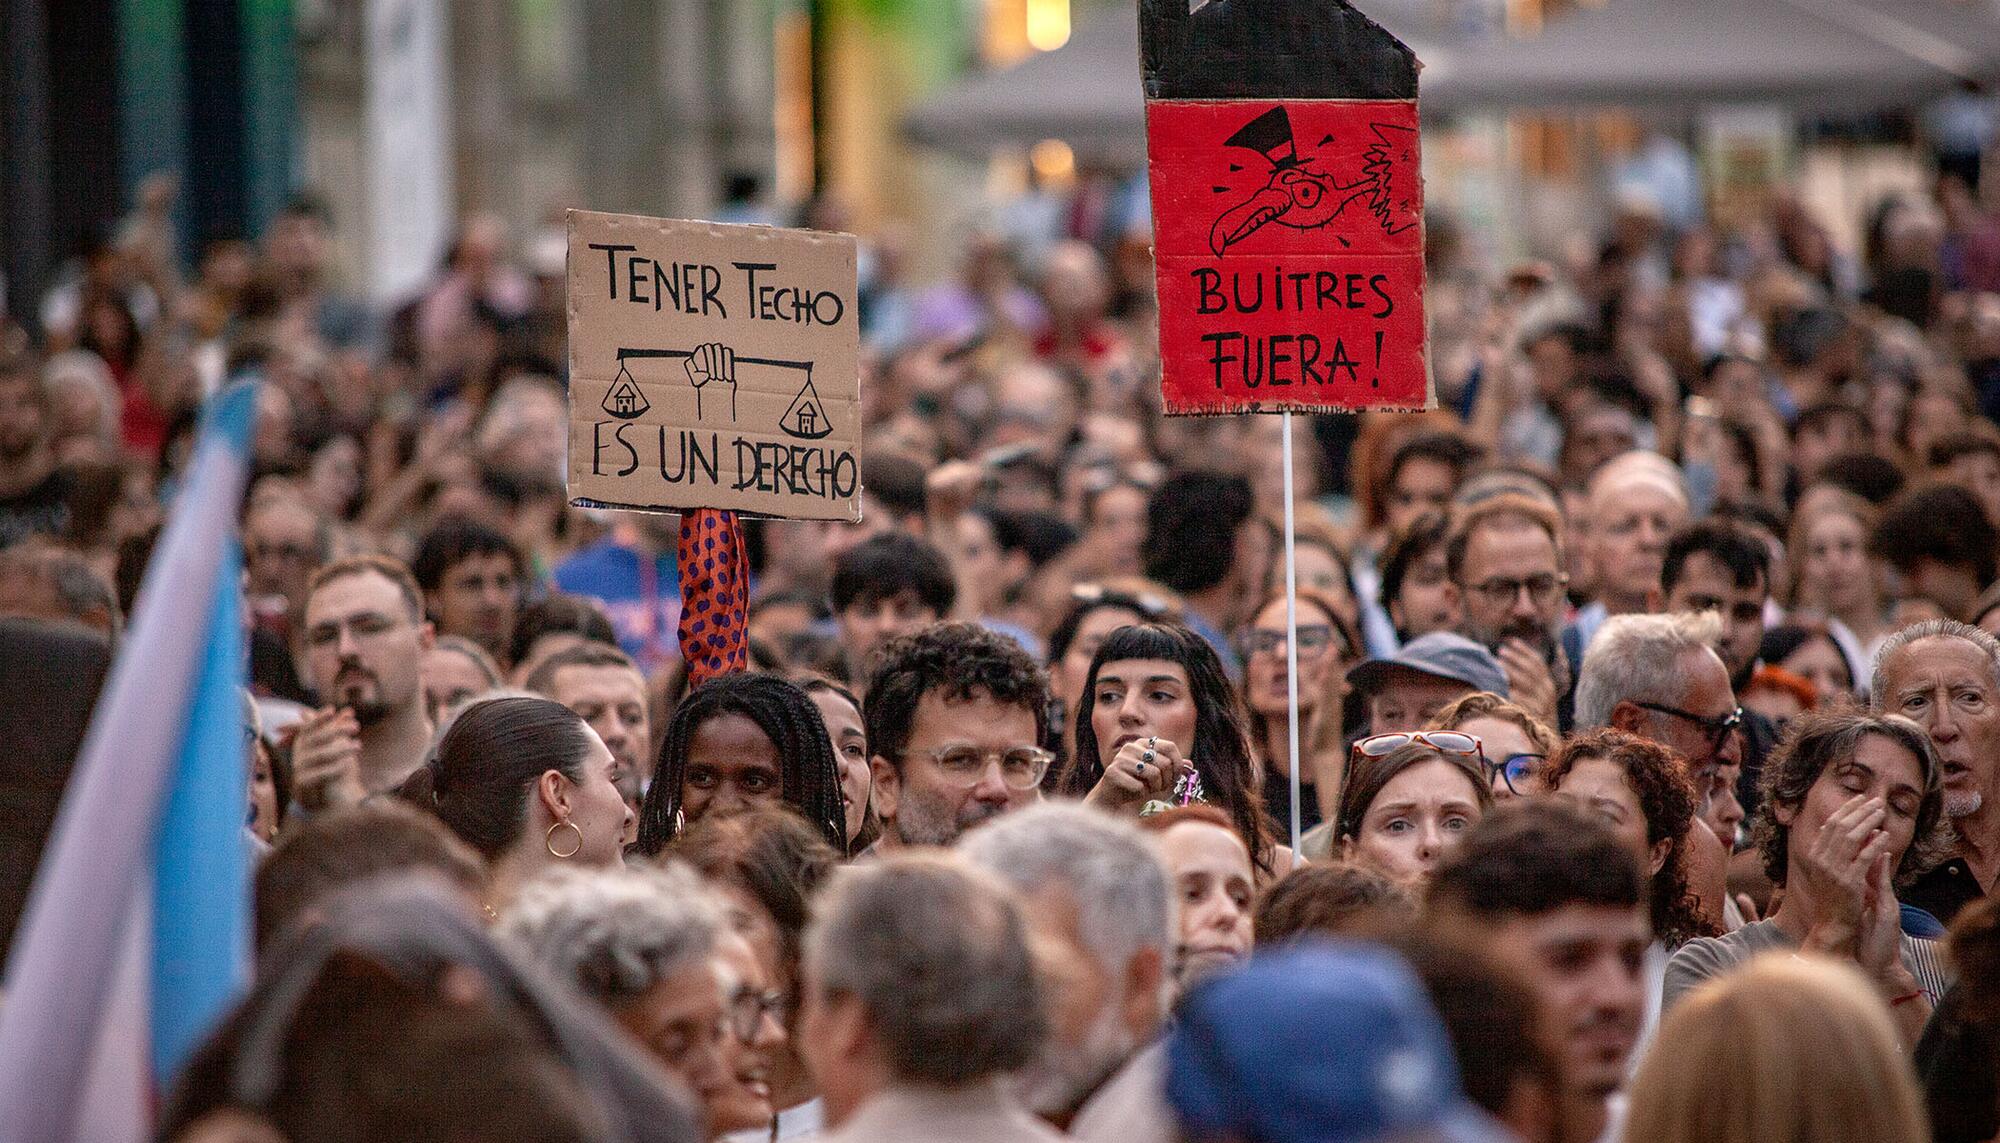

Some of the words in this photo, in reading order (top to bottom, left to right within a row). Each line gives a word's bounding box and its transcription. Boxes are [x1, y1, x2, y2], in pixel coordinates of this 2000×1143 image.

[588, 243, 727, 319] TENER
[732, 262, 844, 326] TECHO
[592, 420, 640, 477] ES
[659, 425, 719, 485] UN
[731, 436, 857, 500] DERECHO
